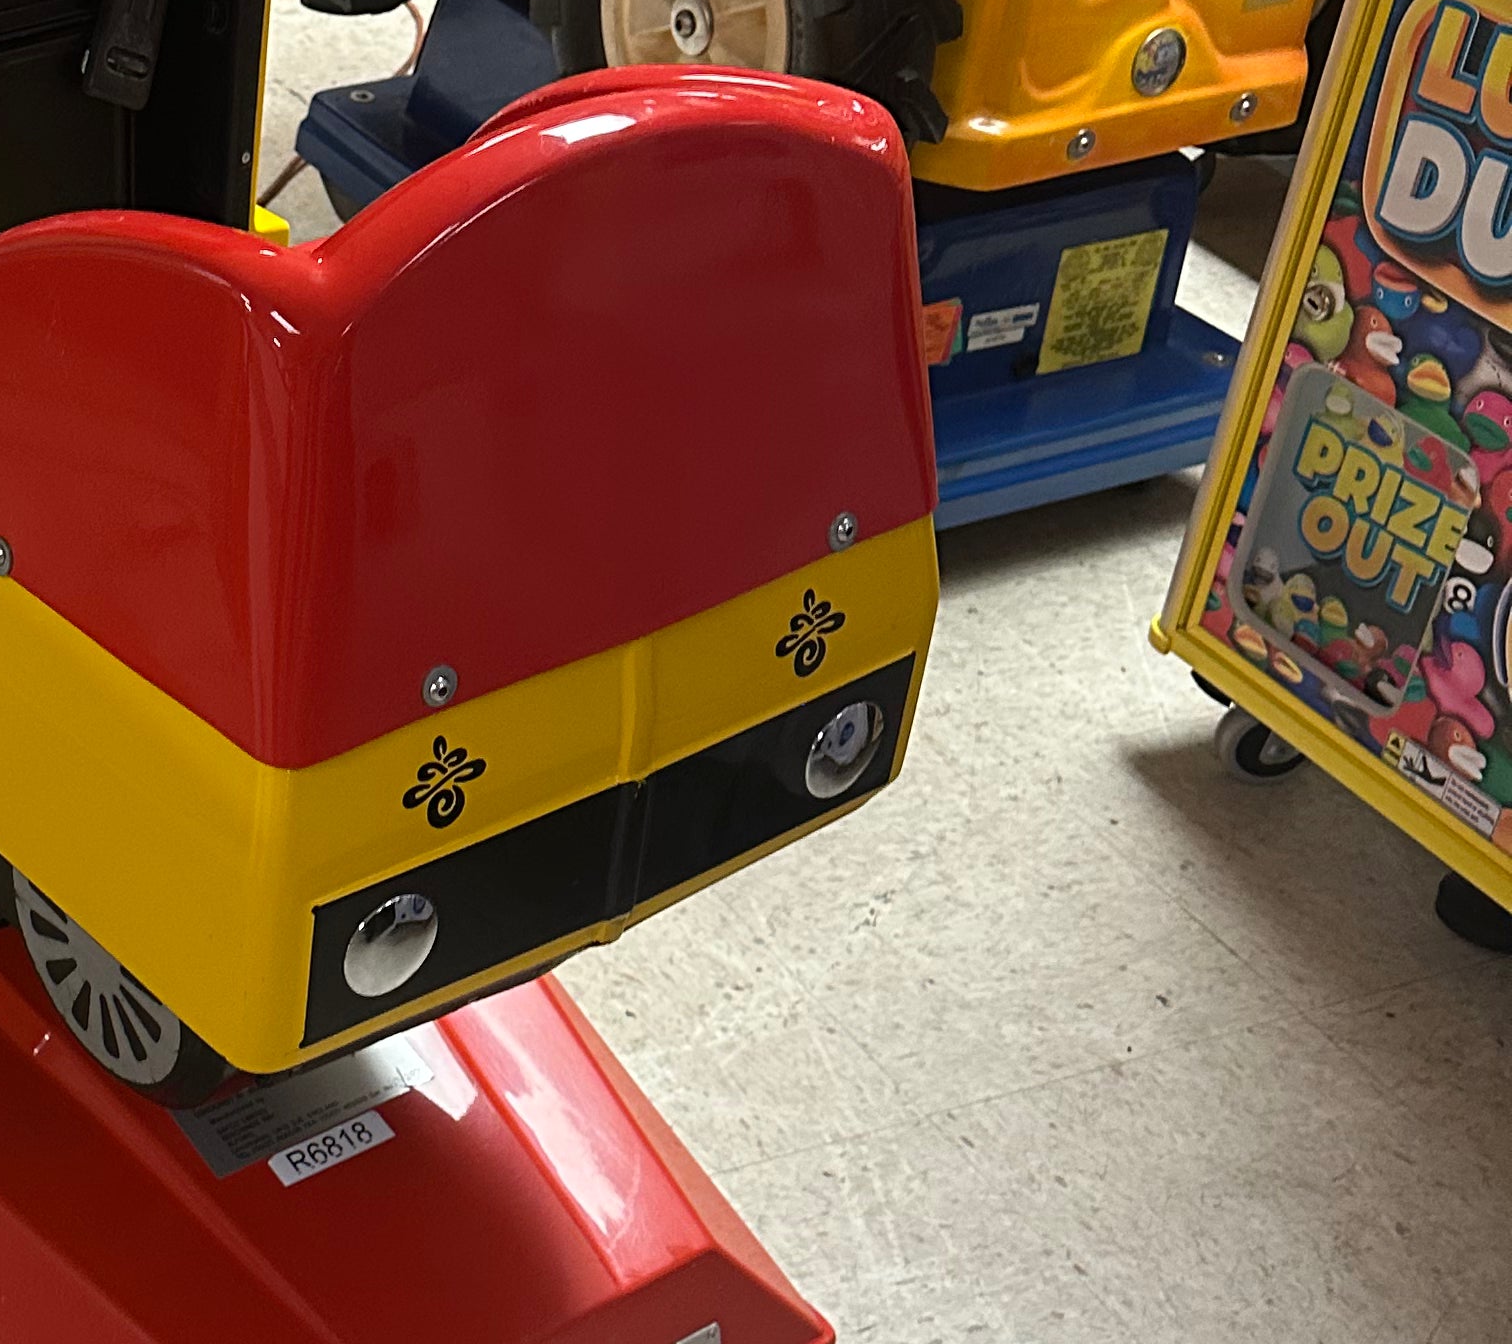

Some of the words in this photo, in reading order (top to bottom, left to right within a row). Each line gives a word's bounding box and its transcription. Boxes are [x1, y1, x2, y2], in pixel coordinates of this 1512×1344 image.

[1294, 418, 1472, 568] PRIZE
[1300, 492, 1440, 612] OUT
[286, 1120, 373, 1174] R6818
